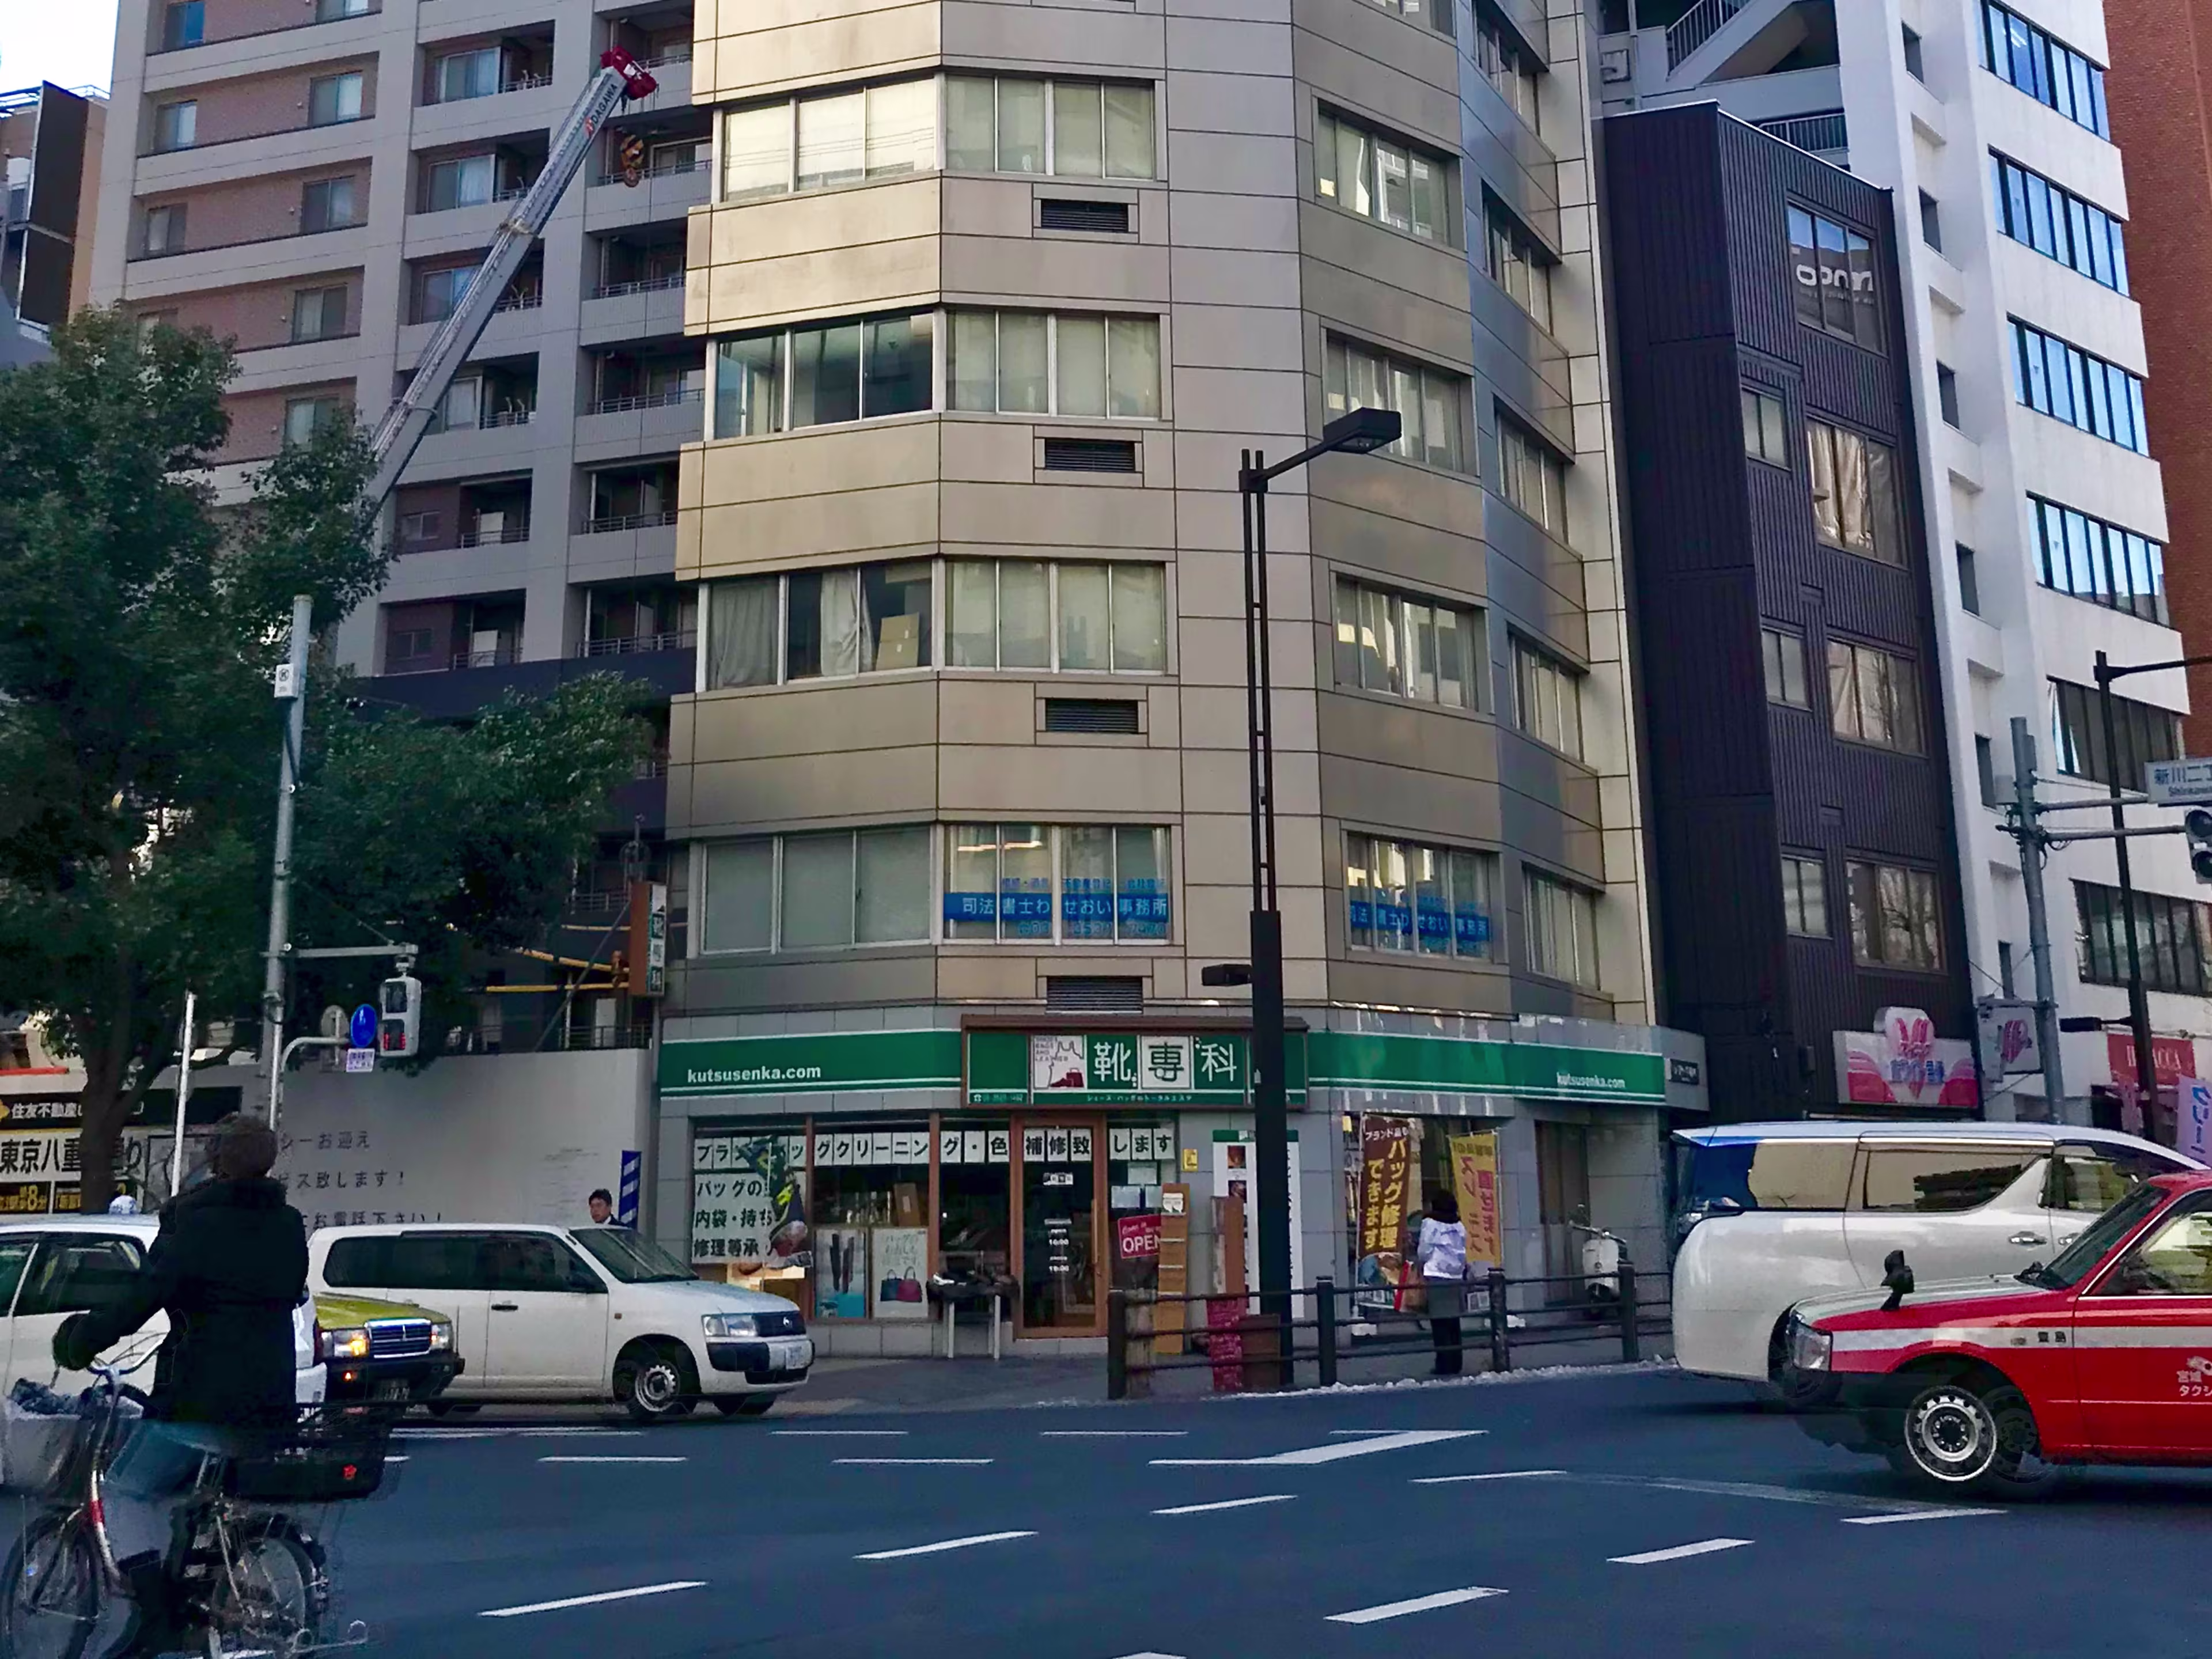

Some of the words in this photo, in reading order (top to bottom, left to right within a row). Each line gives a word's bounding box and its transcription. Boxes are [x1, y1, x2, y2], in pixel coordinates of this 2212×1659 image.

[1094, 1041, 1237, 1082] 靴専科
[687, 1065, 821, 1084] kutsusenka.com
[1556, 1071, 1626, 1089] kutsusenka.com
[12, 1102, 82, 1119] 住友不動産
[697, 1180, 768, 1198] バッグの
[1363, 1157, 1385, 1250] できます
[1123, 1234, 1161, 1253] OPEN
